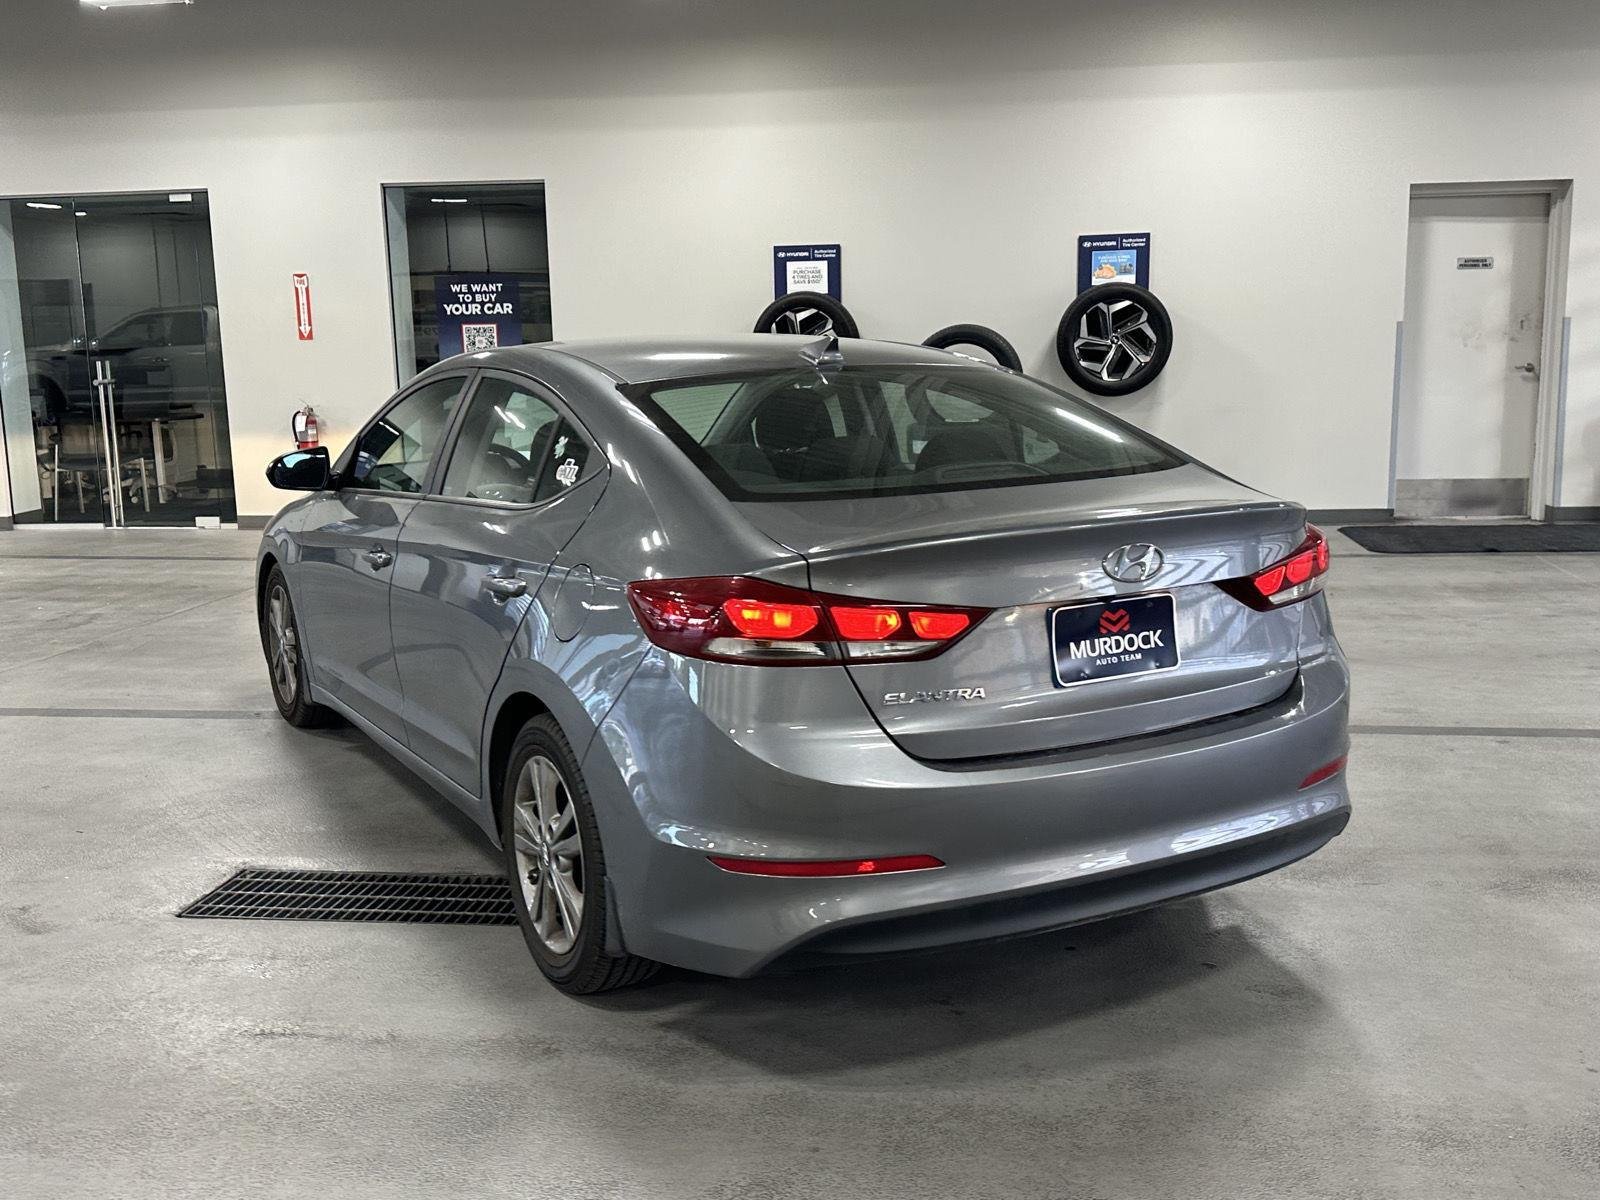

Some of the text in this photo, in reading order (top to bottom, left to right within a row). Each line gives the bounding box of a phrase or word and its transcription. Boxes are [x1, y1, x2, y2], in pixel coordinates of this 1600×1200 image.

[450, 283, 503, 292] WE WANT
[457, 293, 497, 303] TO BUY
[443, 303, 513, 315] YOUR CAR
[1069, 629, 1165, 660] MURDOCK
[1095, 653, 1142, 666] AUTO TEAM
